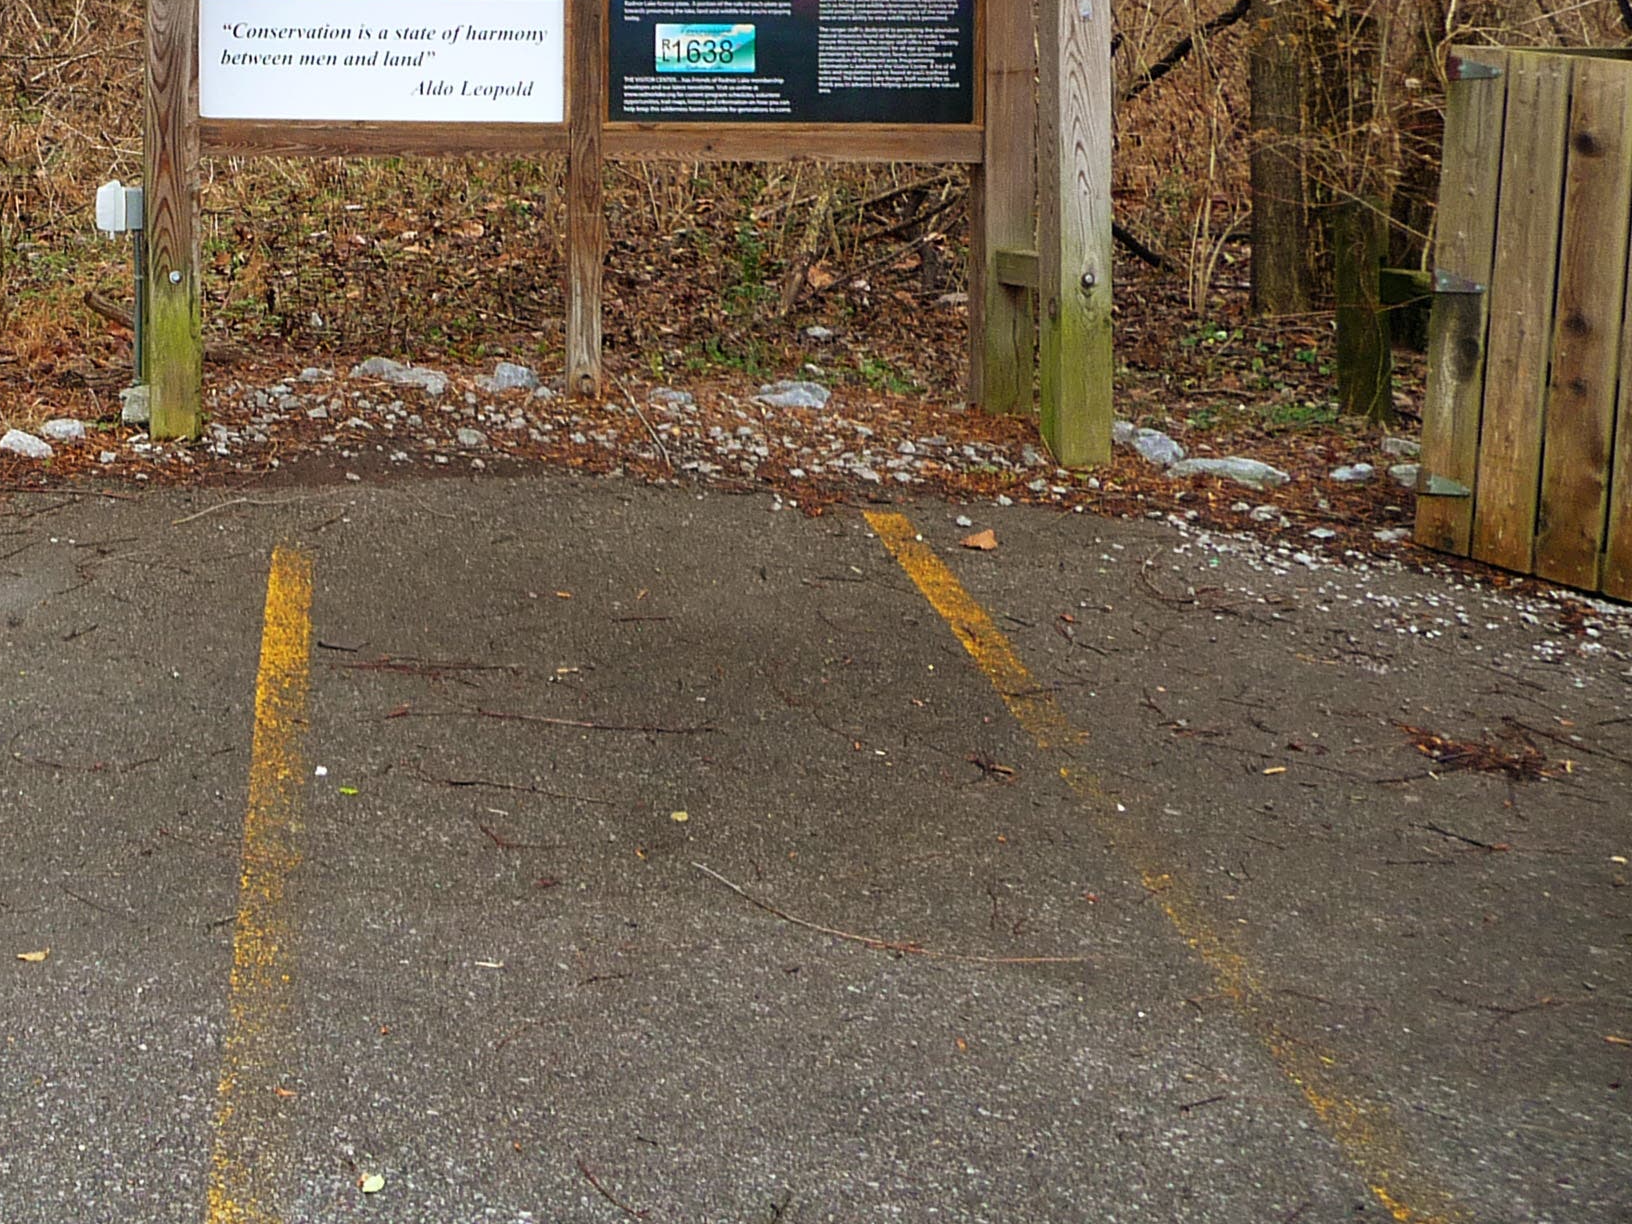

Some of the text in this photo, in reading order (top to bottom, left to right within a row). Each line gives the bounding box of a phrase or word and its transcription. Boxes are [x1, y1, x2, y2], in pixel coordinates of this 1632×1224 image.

[357, 23, 371, 41] is
[378, 29, 389, 41] a
[395, 25, 437, 41] state
[441, 24, 464, 44] of
[465, 25, 548, 45] harmony
[221, 49, 293, 67] between
[299, 53, 337, 67] men
[343, 51, 378, 67] and
[672, 39, 734, 64] 1638
[411, 80, 534, 101] Aldo Leopold
